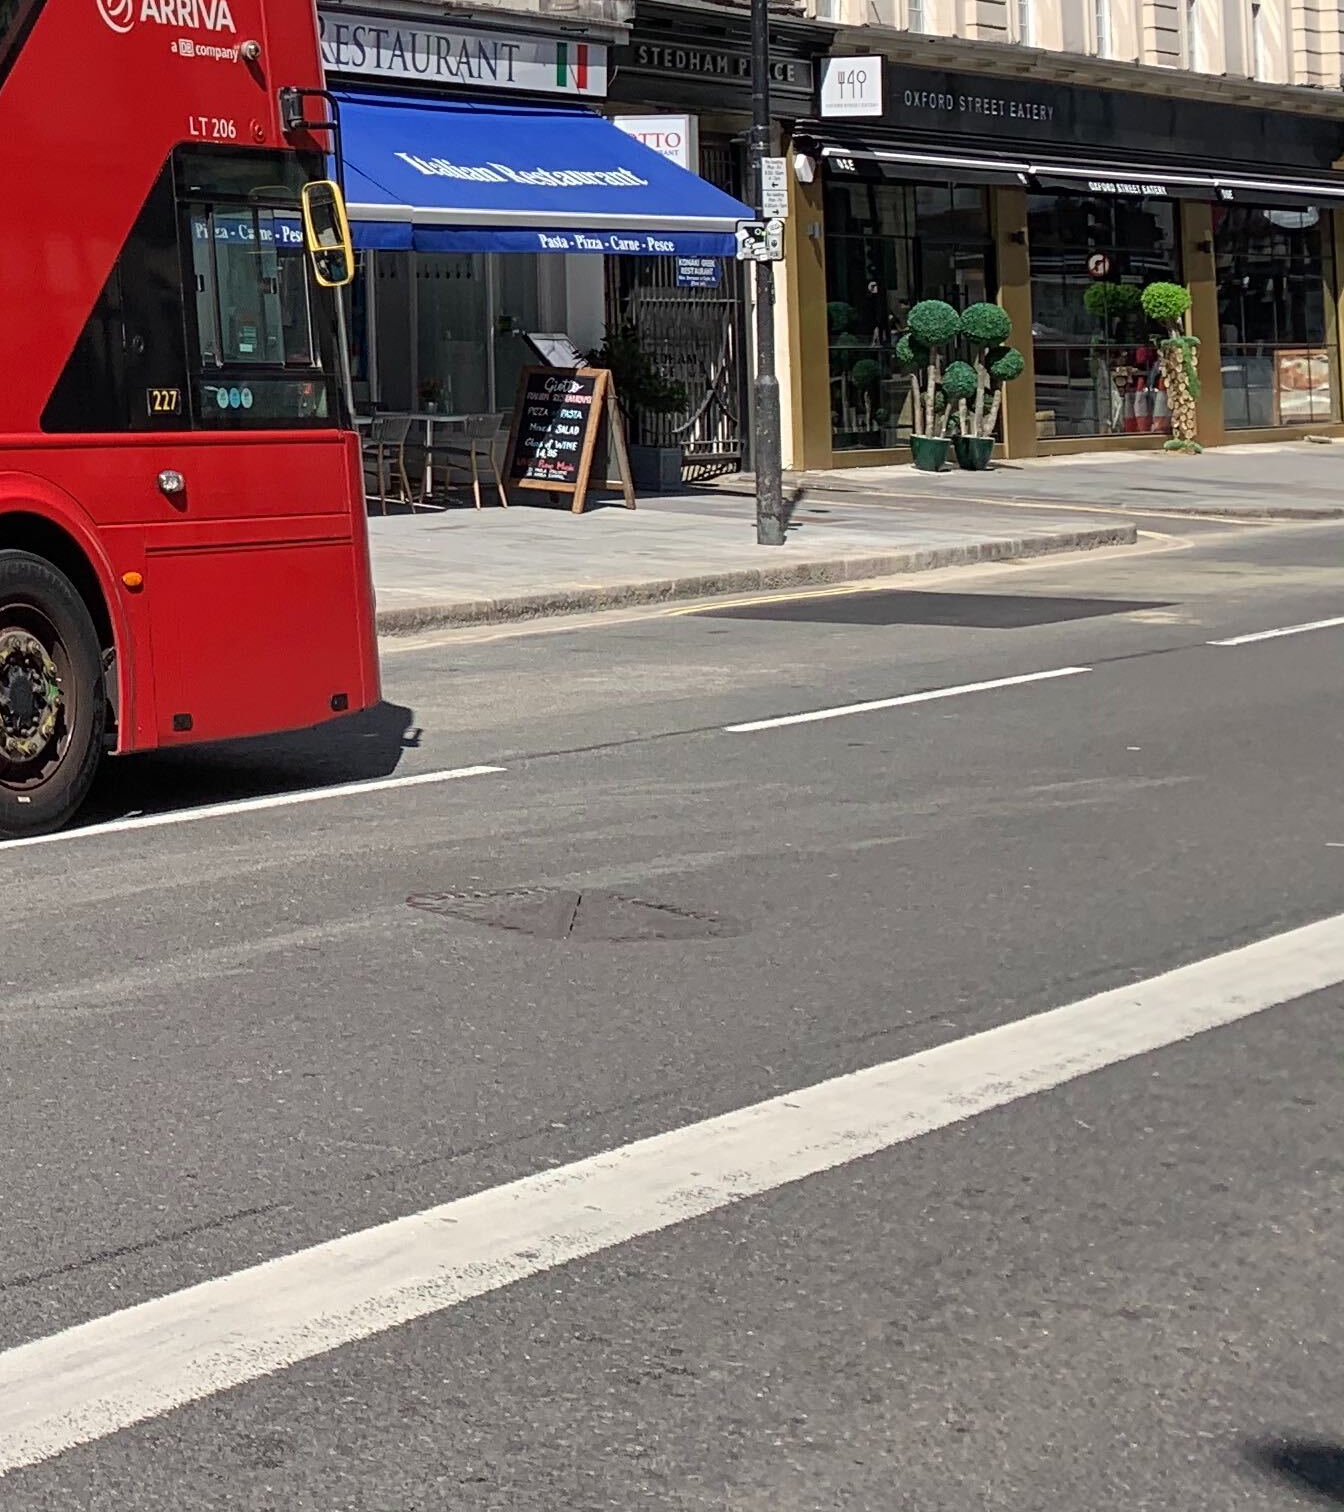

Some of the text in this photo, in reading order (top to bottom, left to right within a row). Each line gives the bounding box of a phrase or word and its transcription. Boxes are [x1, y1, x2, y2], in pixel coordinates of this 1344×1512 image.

[171, 39, 239, 63] a DB company
[638, 46, 796, 82] STEDHAM PCE
[904, 90, 1054, 121] OXFORD STREET EATERY
[189, 116, 236, 138] LT 206
[394, 152, 649, 187] Italian Restaurant
[1088, 182, 1168, 196] OXFORD STREET EATERY
[538, 233, 675, 252] Pasta Pizza Carne Pesce
[152, 390, 178, 411] 227
